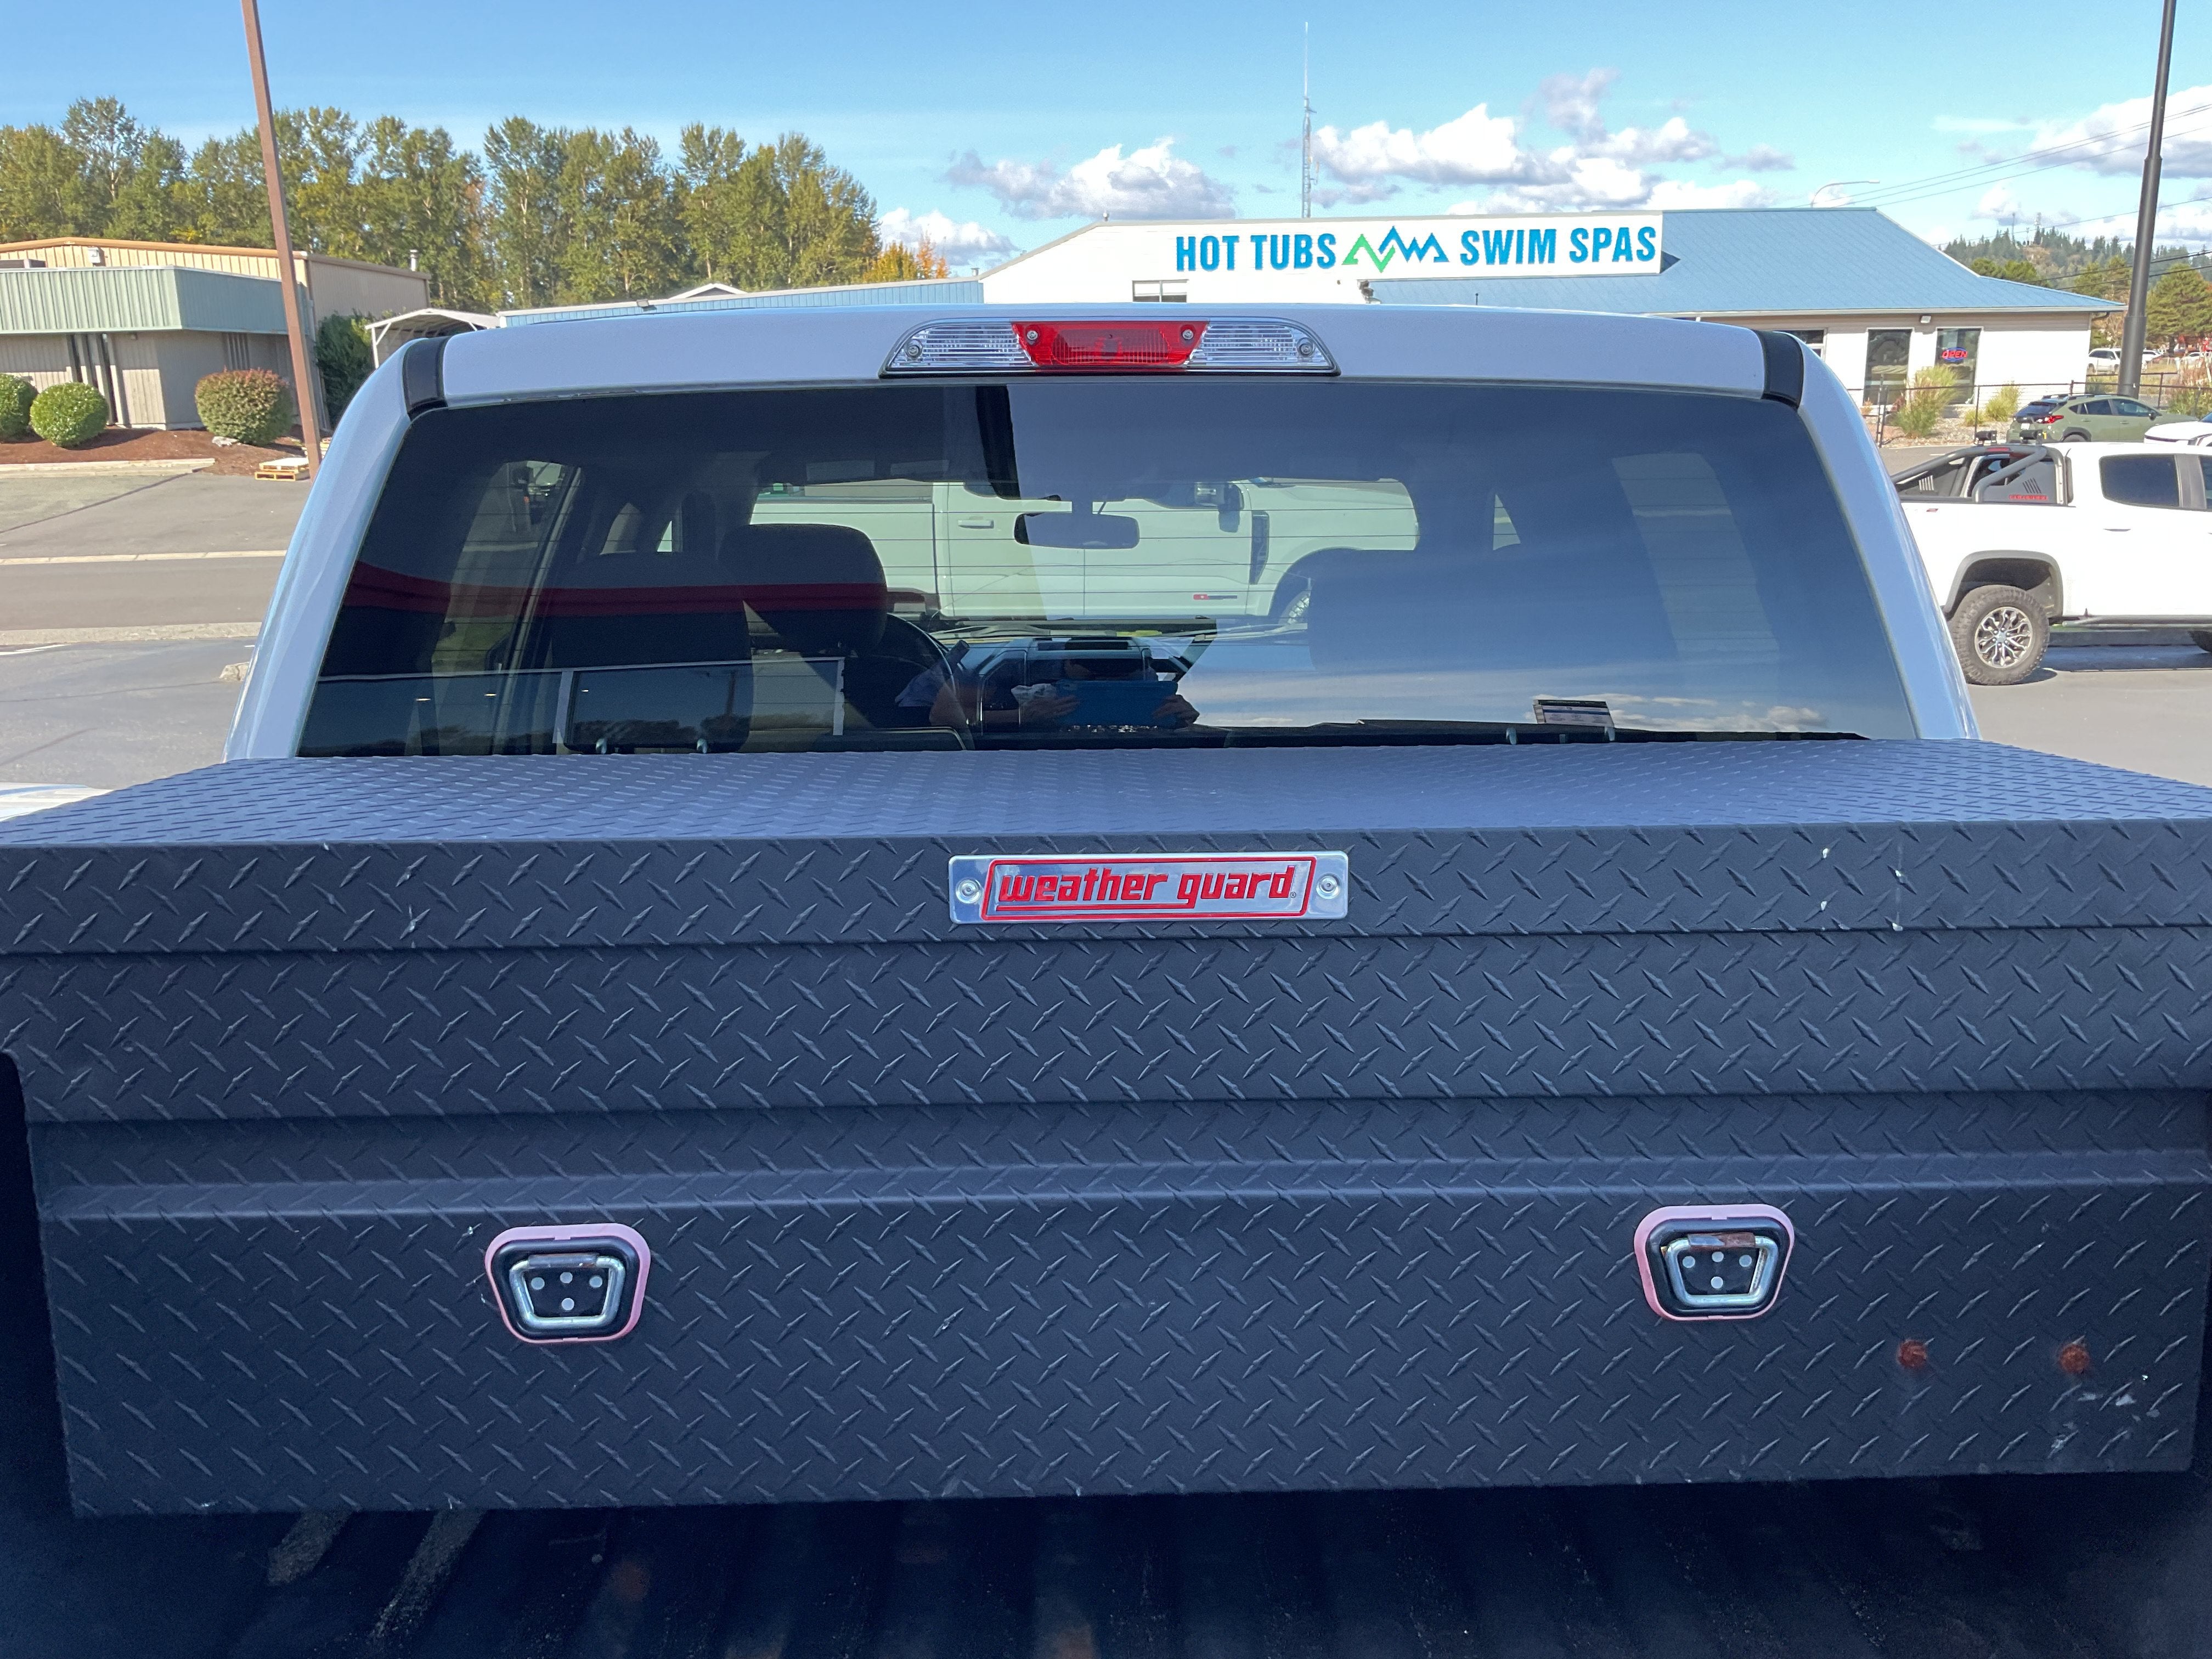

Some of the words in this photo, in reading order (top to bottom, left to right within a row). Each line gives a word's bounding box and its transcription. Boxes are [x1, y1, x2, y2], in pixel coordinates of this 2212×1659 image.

[1176, 235, 1240, 272] HOT
[1250, 233, 1336, 270] TUBS
[1459, 228, 1557, 266] SWIM
[1568, 225, 1656, 264] SPAS
[1942, 349, 1968, 359] OPEN
[998, 867, 1169, 902] weather
[1177, 865, 1295, 909] guard
